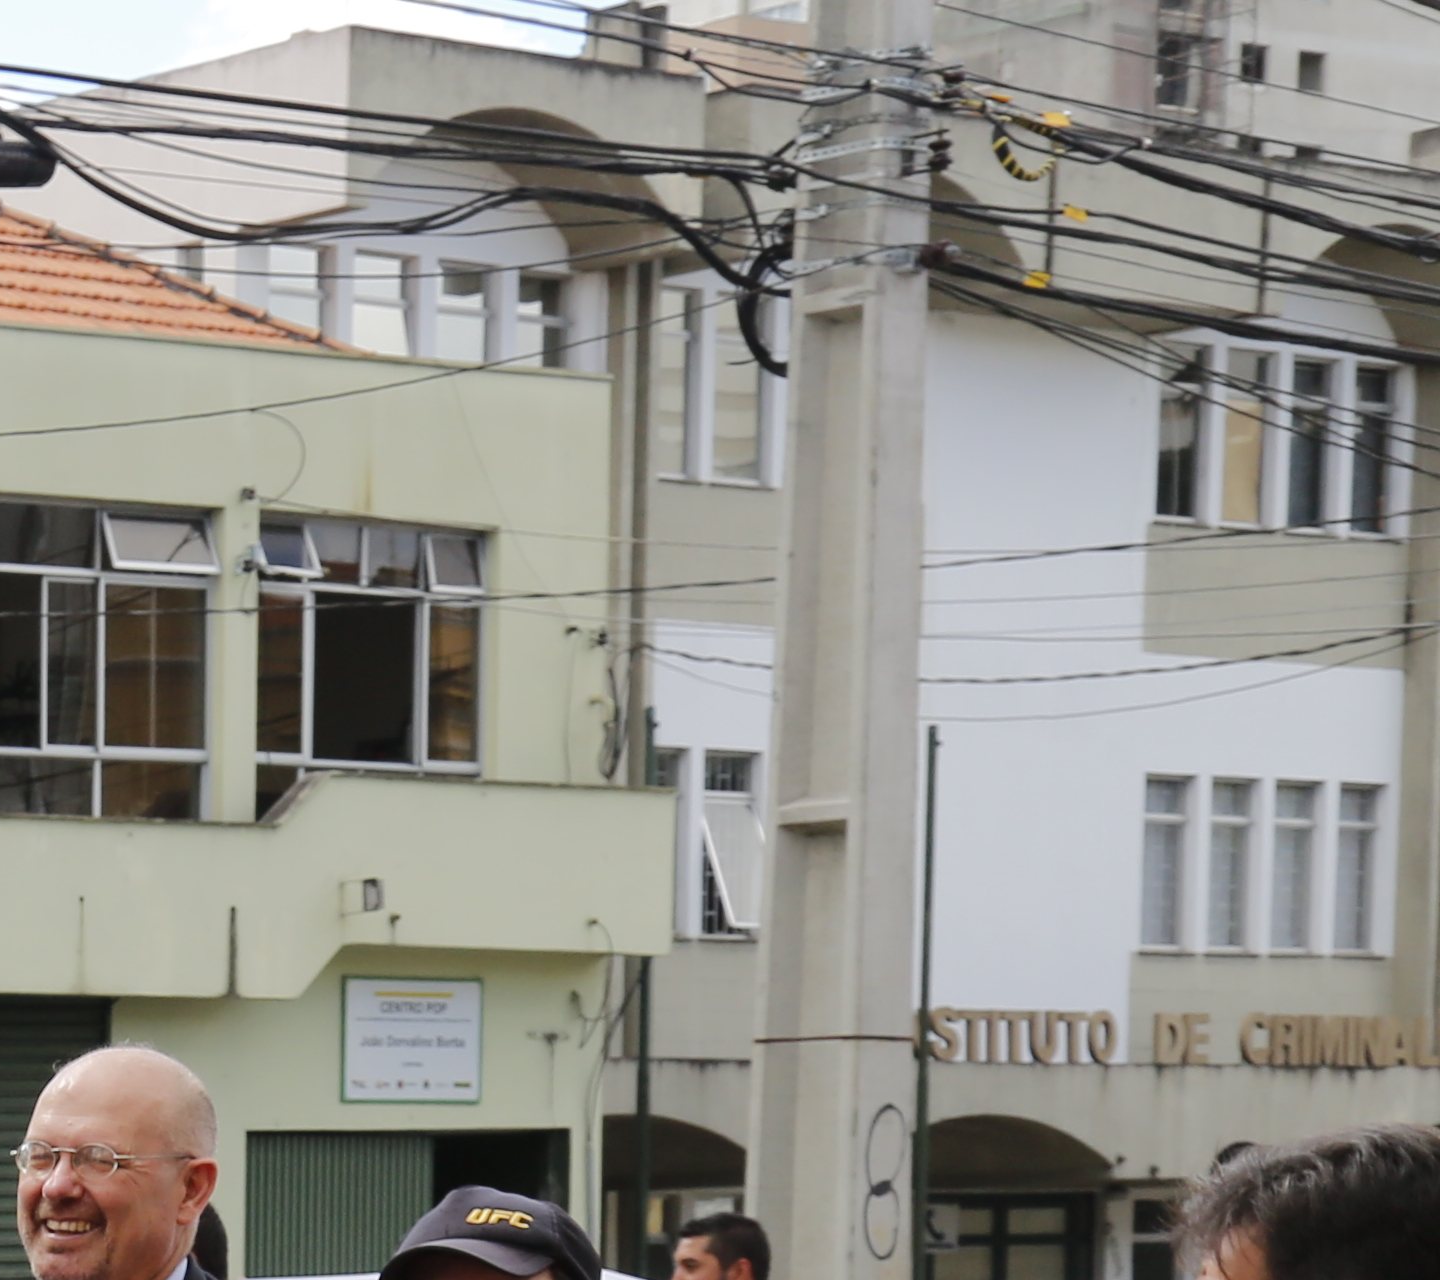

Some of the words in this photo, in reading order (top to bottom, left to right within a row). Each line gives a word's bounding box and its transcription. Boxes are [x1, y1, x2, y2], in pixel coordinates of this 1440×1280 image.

[914, 1007, 1118, 1066] STITUTO
[1154, 1012, 1210, 1065] DE
[1240, 1012, 1440, 1068] CRIMINAL
[465, 1207, 535, 1230] UFC
